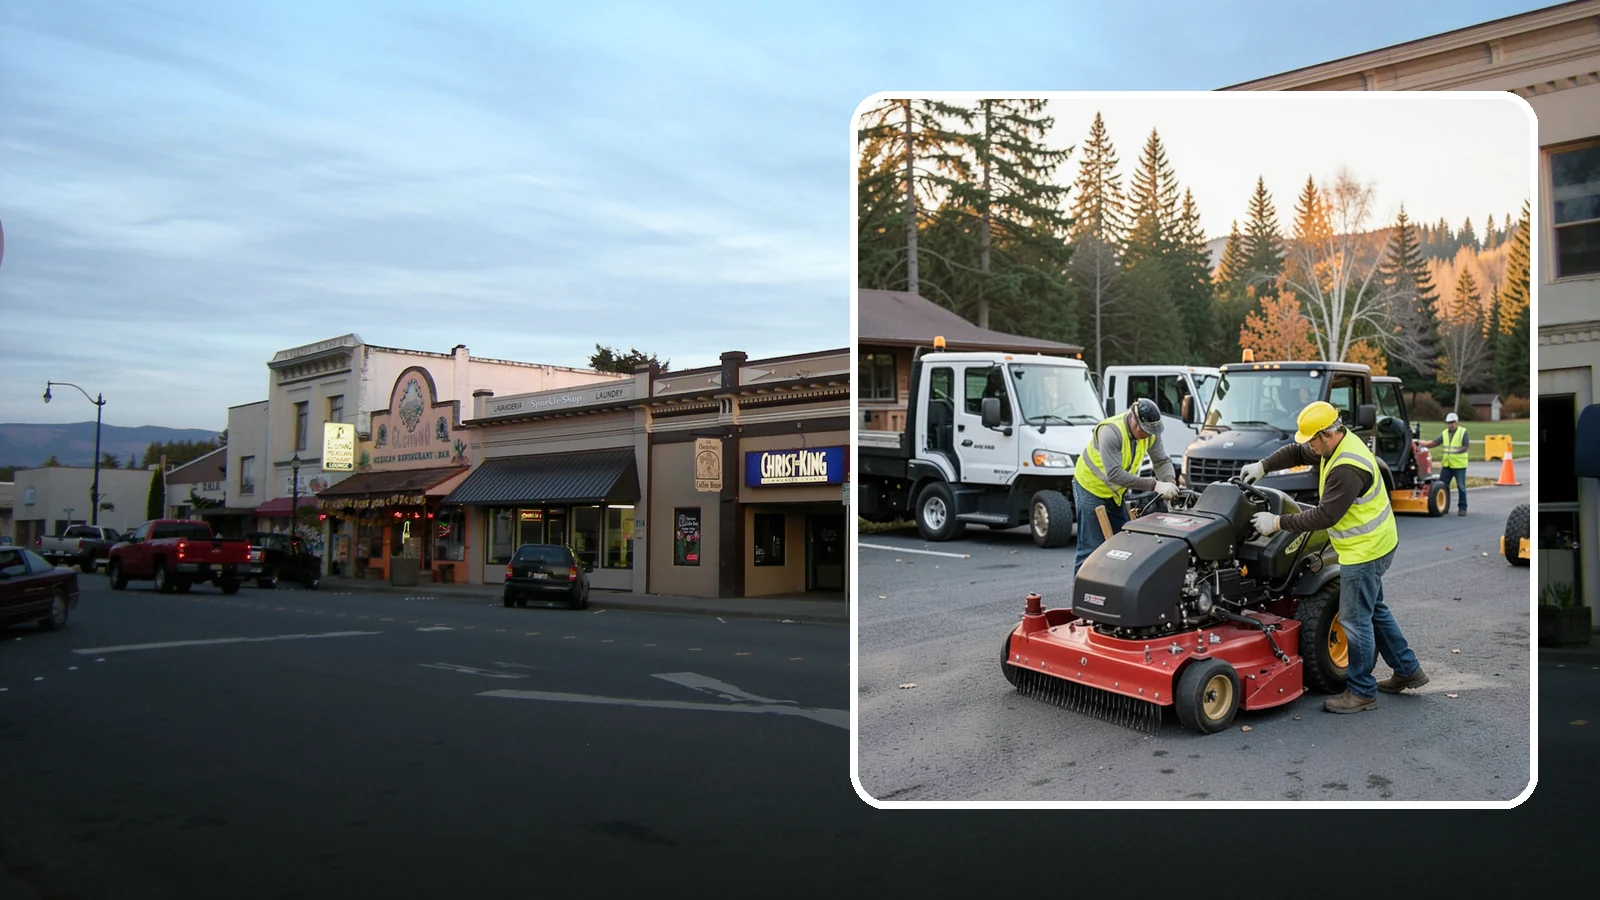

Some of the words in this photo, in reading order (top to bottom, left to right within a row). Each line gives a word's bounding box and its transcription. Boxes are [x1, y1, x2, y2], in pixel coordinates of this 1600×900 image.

[493, 402, 523, 413] LAVANDERIA
[530, 396, 559, 409] Sparkle
[561, 394, 582, 406] Shop
[595, 389, 623, 400] LAUNDRY
[402, 421, 431, 448] GITANO
[373, 455, 396, 464] MEXICAN
[397, 452, 434, 462] RESTAURANT
[437, 450, 450, 459] BAR
[760, 451, 798, 478] CHRIST
[799, 450, 827, 476] KING
